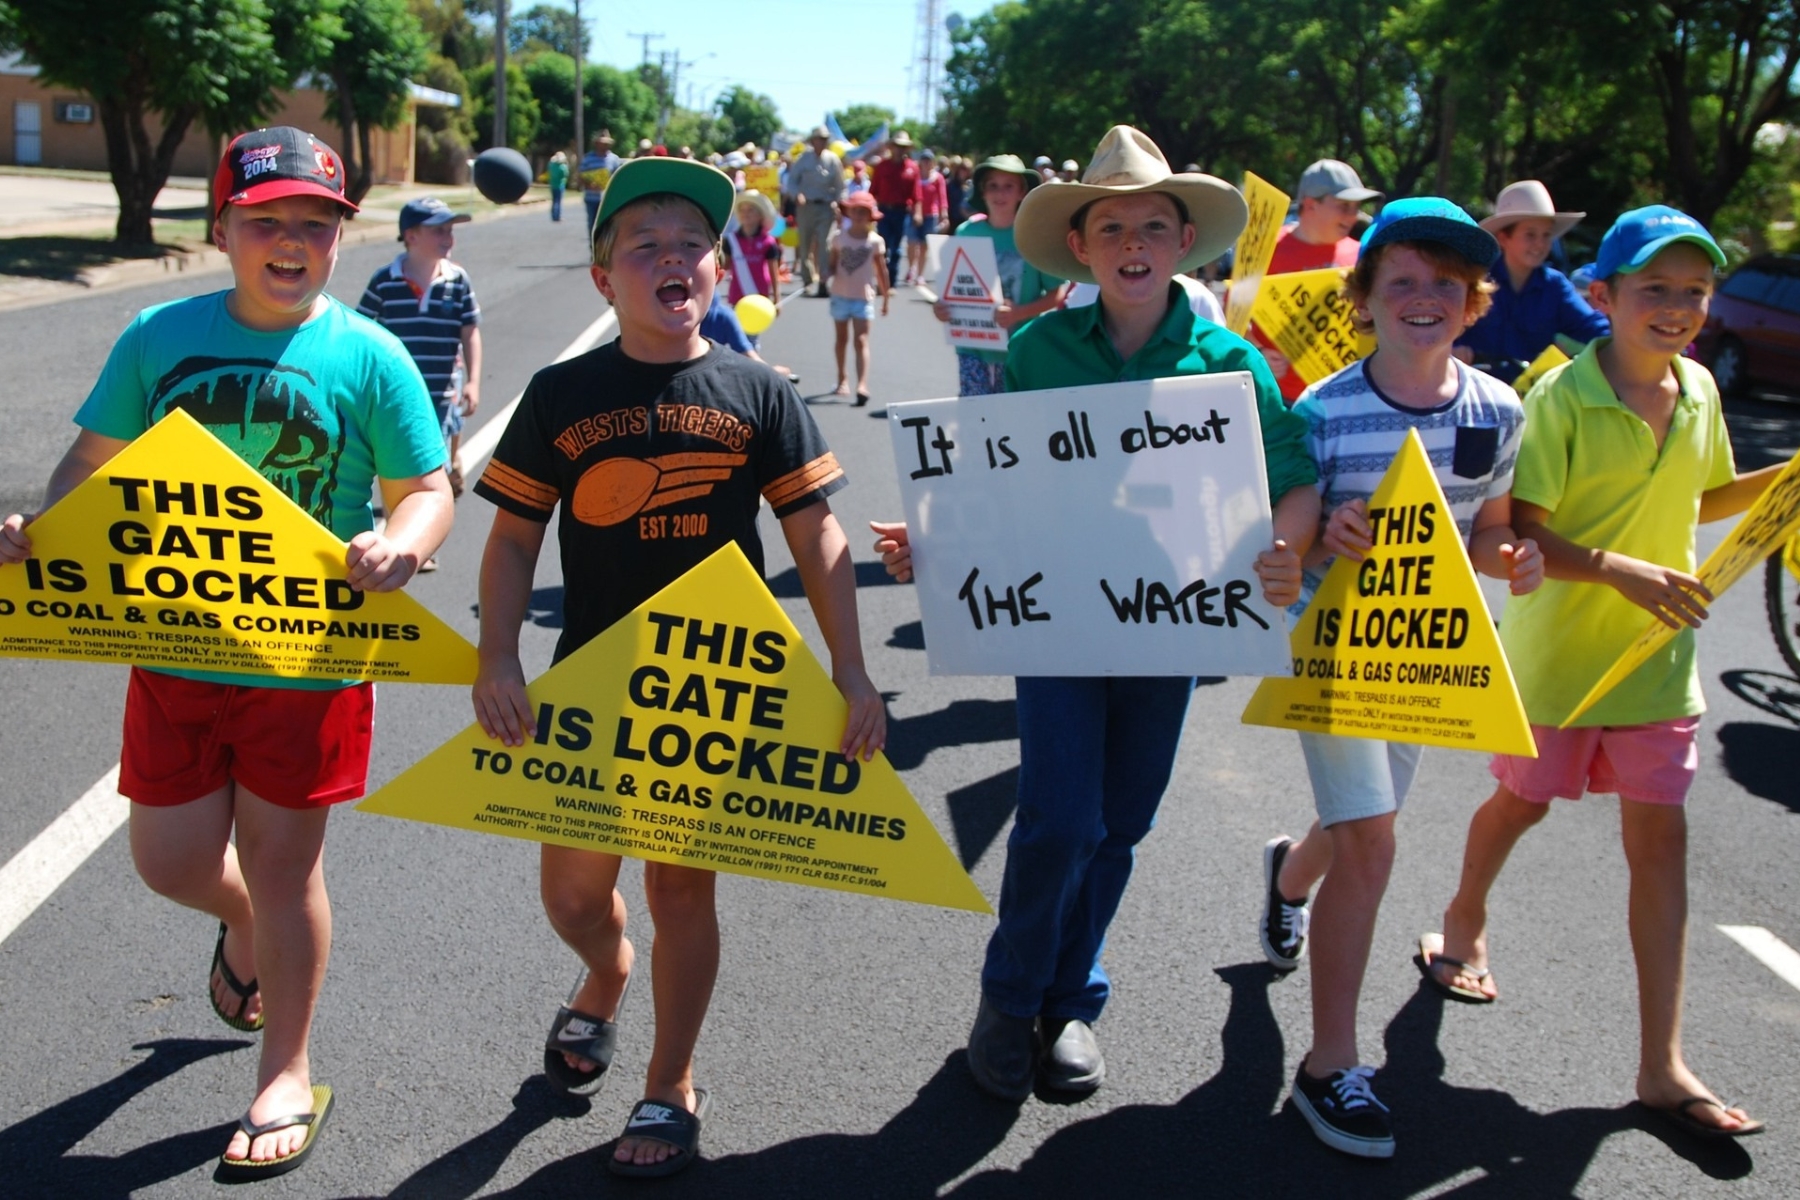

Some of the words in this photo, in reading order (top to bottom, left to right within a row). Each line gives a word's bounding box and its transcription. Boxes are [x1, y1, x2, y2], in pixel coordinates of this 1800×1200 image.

[243, 156, 277, 180] 2014
[1290, 283, 1310, 308] IS
[1307, 304, 1358, 366] LOCKE
[554, 406, 648, 461] WESTS
[656, 404, 754, 452] TIGERS
[901, 416, 954, 480] It
[980, 417, 1019, 469] is
[1048, 410, 1097, 462] all
[1120, 409, 1230, 454] about
[110, 476, 264, 520] THIS
[108, 520, 276, 564] GATE
[639, 515, 668, 540] EST
[672, 513, 708, 538] 2000
[1369, 502, 1436, 546] THIS
[26, 558, 87, 594] IS
[111, 563, 364, 612] LOCKED
[1358, 554, 1435, 598] GATE
[0, 598, 16, 616] O
[26, 600, 114, 621] COAL
[124, 606, 148, 624] &
[158, 608, 222, 629] GAS
[232, 614, 420, 642] COMPANIES
[958, 567, 1051, 630] THE
[1100, 576, 1270, 631] WATER
[68, 626, 142, 641] WARNING:
[146, 630, 221, 646] TRESPASS
[225, 635, 238, 647] IS
[242, 636, 262, 648] AN
[266, 638, 333, 653] OFFENCE
[646, 610, 788, 675] THIS
[1314, 608, 1342, 648] IS
[1348, 607, 1470, 650] LOCKED
[2, 636, 64, 647] ADMITTANCE
[67, 640, 81, 648] TO
[84, 641, 104, 650] THIS
[108, 642, 158, 653] PROPERTY
[161, 646, 170, 654] IS
[173, 643, 210, 656] ONLY
[214, 649, 227, 657] BY
[230, 650, 281, 661] INVITATION
[284, 653, 298, 662] OR
[300, 654, 330, 663] PRIOR
[332, 656, 400, 668] APPOINTMENT
[58, 647, 82, 656] HIGH
[84, 649, 118, 659] COURT
[120, 651, 134, 660] OF
[136, 652, 190, 663] AUSTRALIA
[192, 655, 230, 666] PLENTY
[232, 658, 238, 666] V
[240, 658, 276, 668] DILLON
[308, 662, 323, 671] 171
[325, 663, 345, 673] CLR
[1292, 658, 1304, 677] O
[1308, 658, 1343, 679] COAL
[1348, 660, 1358, 680] &
[1363, 661, 1392, 682] GAS
[1397, 662, 1491, 688] COMPANIES
[628, 666, 788, 730] GATE
[535, 702, 596, 753] IS
[612, 716, 861, 796] LOCKED
[472, 748, 512, 774] TO
[522, 757, 606, 792] COAL
[615, 773, 638, 798] &
[650, 779, 713, 809] GAS
[722, 791, 907, 841] COMPANIES
[485, 802, 547, 821] ADMITTANCE
[549, 813, 562, 824] TO
[564, 816, 586, 828] THIS
[588, 819, 640, 837] PROPERTY
[642, 828, 650, 838] IS
[653, 827, 692, 845] ONLY
[694, 837, 708, 848] BY
[710, 839, 761, 857] INVITATION
[763, 848, 778, 859] OR
[780, 851, 810, 864] PRIOR
[810, 856, 879, 876] APPOINTMENT
[555, 795, 627, 819] WARNING:
[632, 808, 705, 832] TRESPASS
[708, 820, 722, 834] IS
[726, 823, 746, 838] AN
[750, 827, 816, 849] OFFENCE
[473, 813, 530, 830] AUTHORITY
[536, 823, 560, 835] HIGH
[562, 827, 596, 841] COURT
[598, 833, 611, 844] OF
[612, 835, 666, 853] AUSTRALIA
[669, 845, 708, 859] PLENTY
[709, 851, 717, 861] V
[717, 852, 754, 867] DILLON
[754, 858, 782, 871] (1991)
[784, 863, 800, 874] 171
[802, 866, 822, 878] CLR
[823, 870, 840, 881] 635
[566, 1017, 597, 1036] NIKE
[636, 1104, 674, 1120] NIKE
